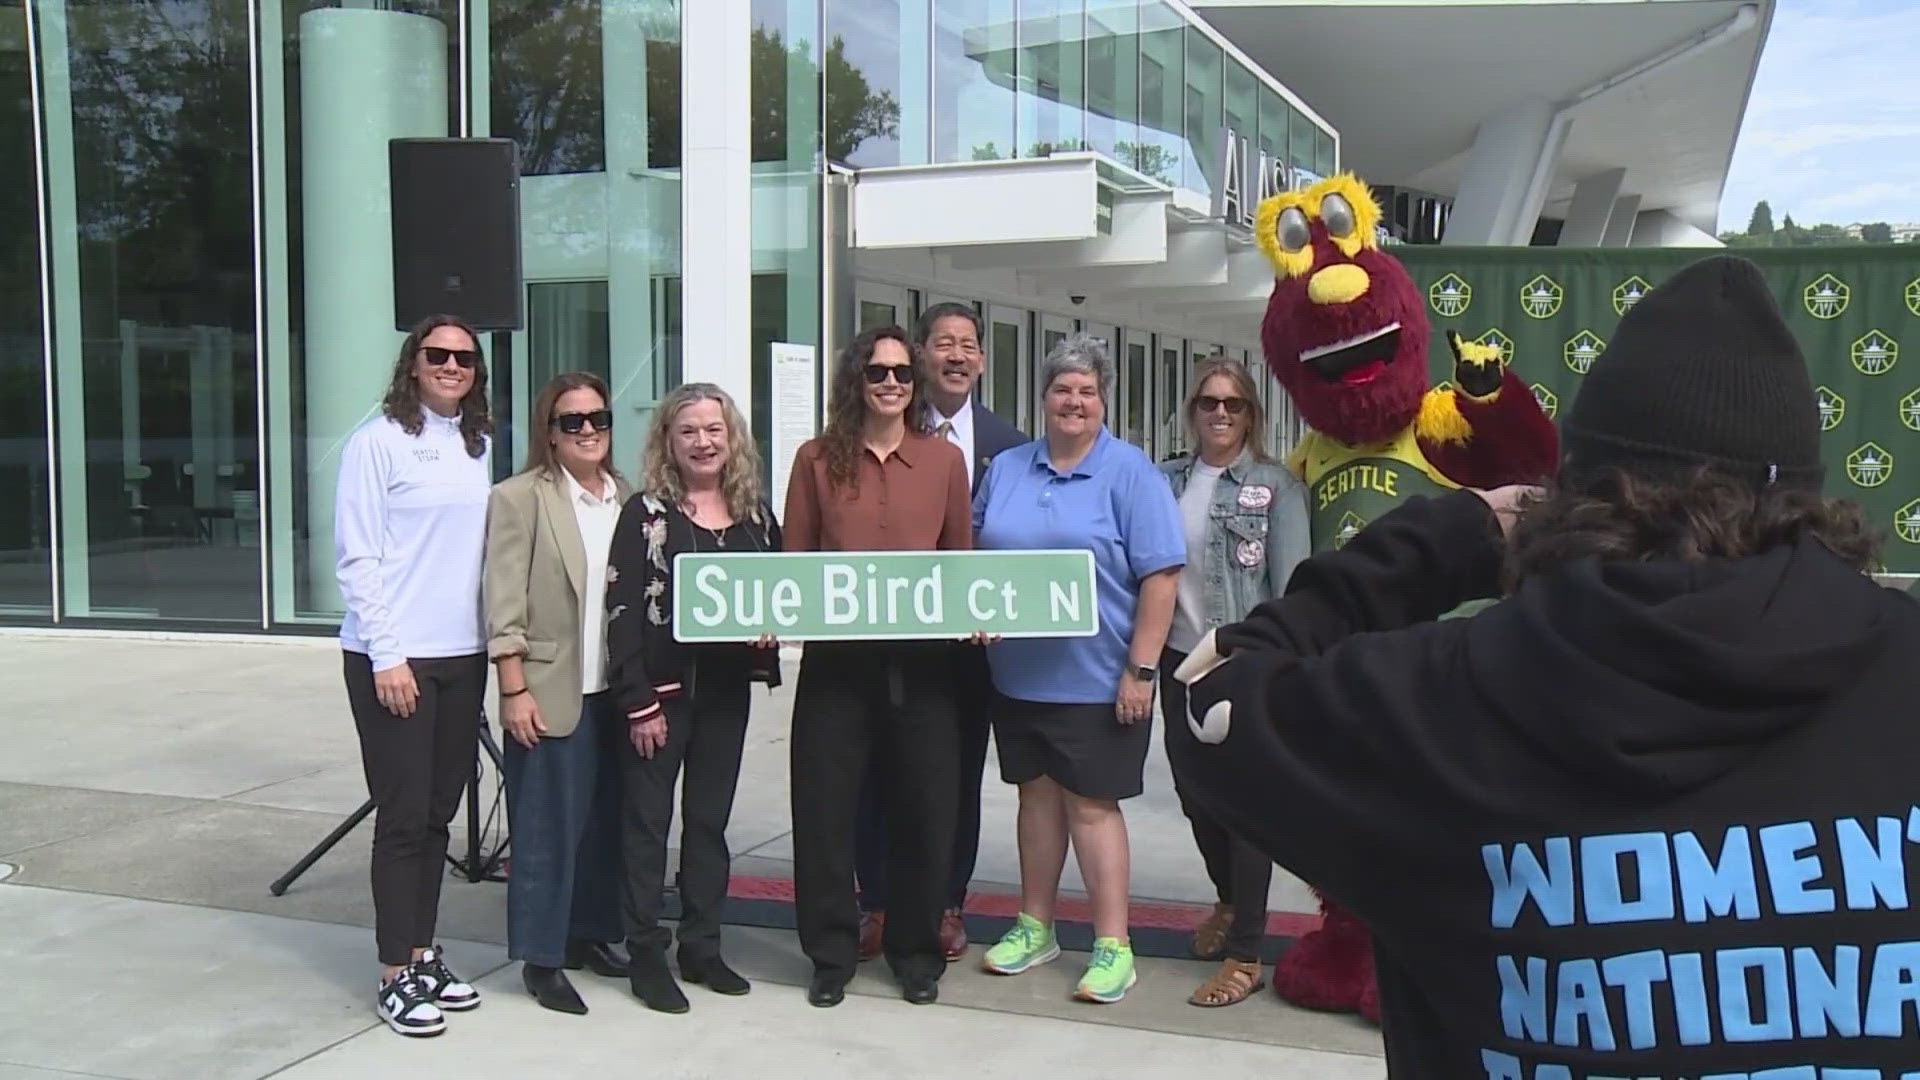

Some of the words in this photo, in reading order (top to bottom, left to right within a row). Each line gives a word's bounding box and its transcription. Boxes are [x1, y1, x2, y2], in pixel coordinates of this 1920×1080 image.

[1319, 465, 1398, 511] SEATTLE
[693, 564, 801, 626] Sue
[823, 563, 944, 625] Bird
[967, 579, 1019, 621] Ct
[1049, 581, 1080, 622] N
[1497, 941, 1920, 1051] NATIONA
